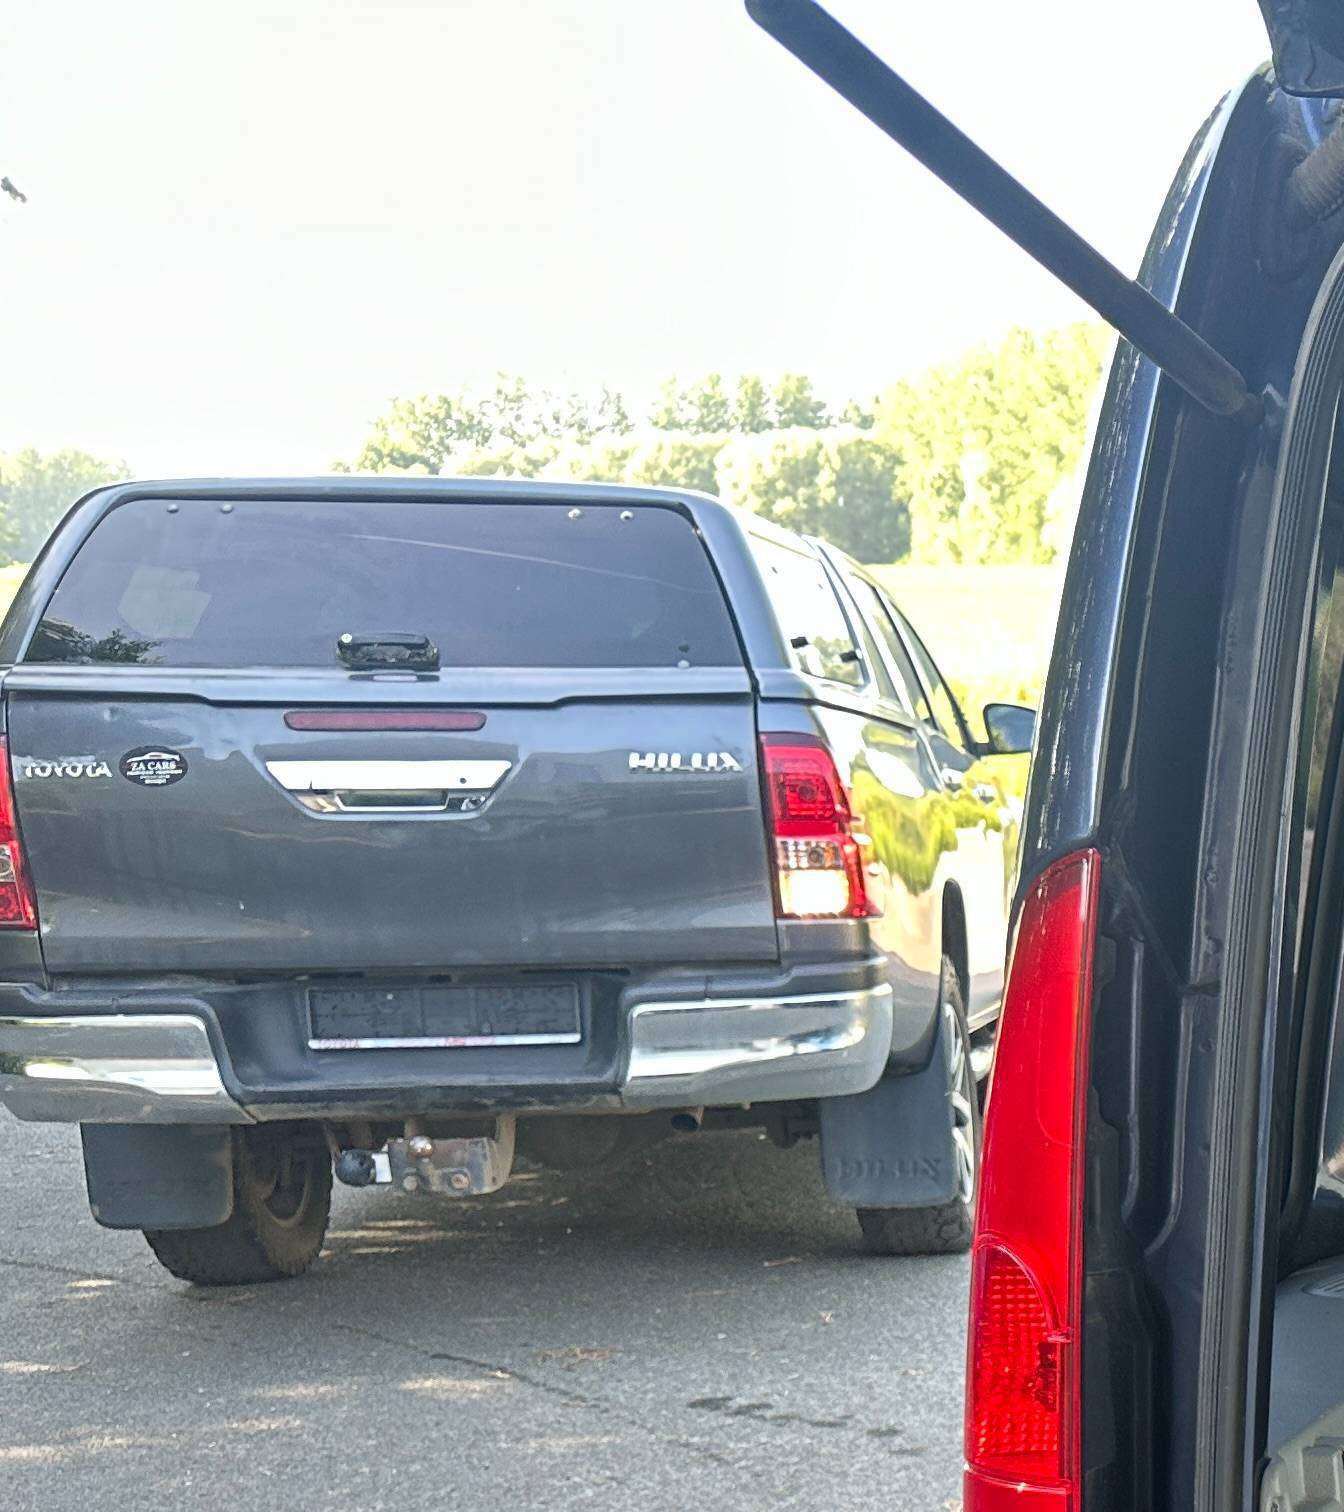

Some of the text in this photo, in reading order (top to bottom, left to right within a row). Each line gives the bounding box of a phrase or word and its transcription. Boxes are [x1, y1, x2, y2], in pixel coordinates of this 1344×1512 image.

[25, 761, 113, 778] TOYOTA
[147, 761, 177, 771] CARS
[629, 752, 743, 772] HILUX
